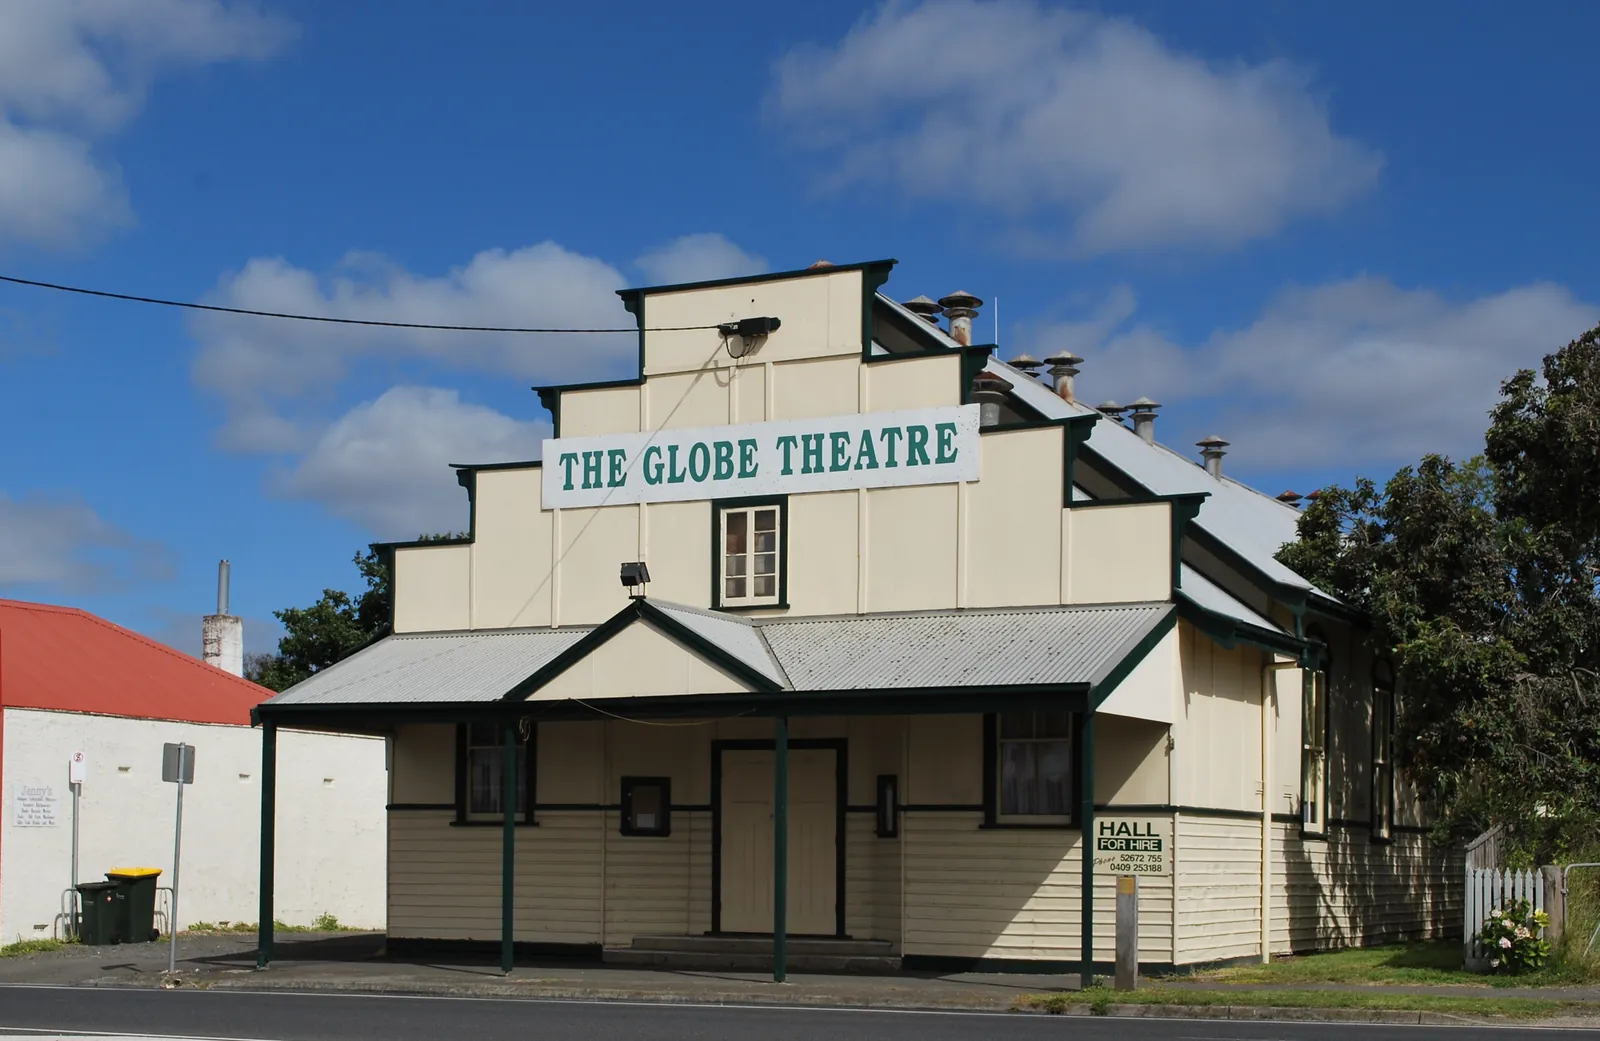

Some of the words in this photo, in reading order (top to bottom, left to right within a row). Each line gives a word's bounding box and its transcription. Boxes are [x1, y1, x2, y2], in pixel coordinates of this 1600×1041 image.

[559, 448, 628, 491] THE
[642, 438, 760, 486] GLOBE
[776, 422, 959, 476] THEATRE
[21, 785, 53, 798] Jenny's
[1099, 821, 1160, 837] HALL
[1100, 839, 1126, 850] FOR
[1130, 839, 1159, 850] HIRE
[1120, 854, 1145, 863] 52672
[1147, 854, 1162, 863] 755
[1110, 863, 1131, 872] 0409
[1133, 864, 1162, 873] 253188
